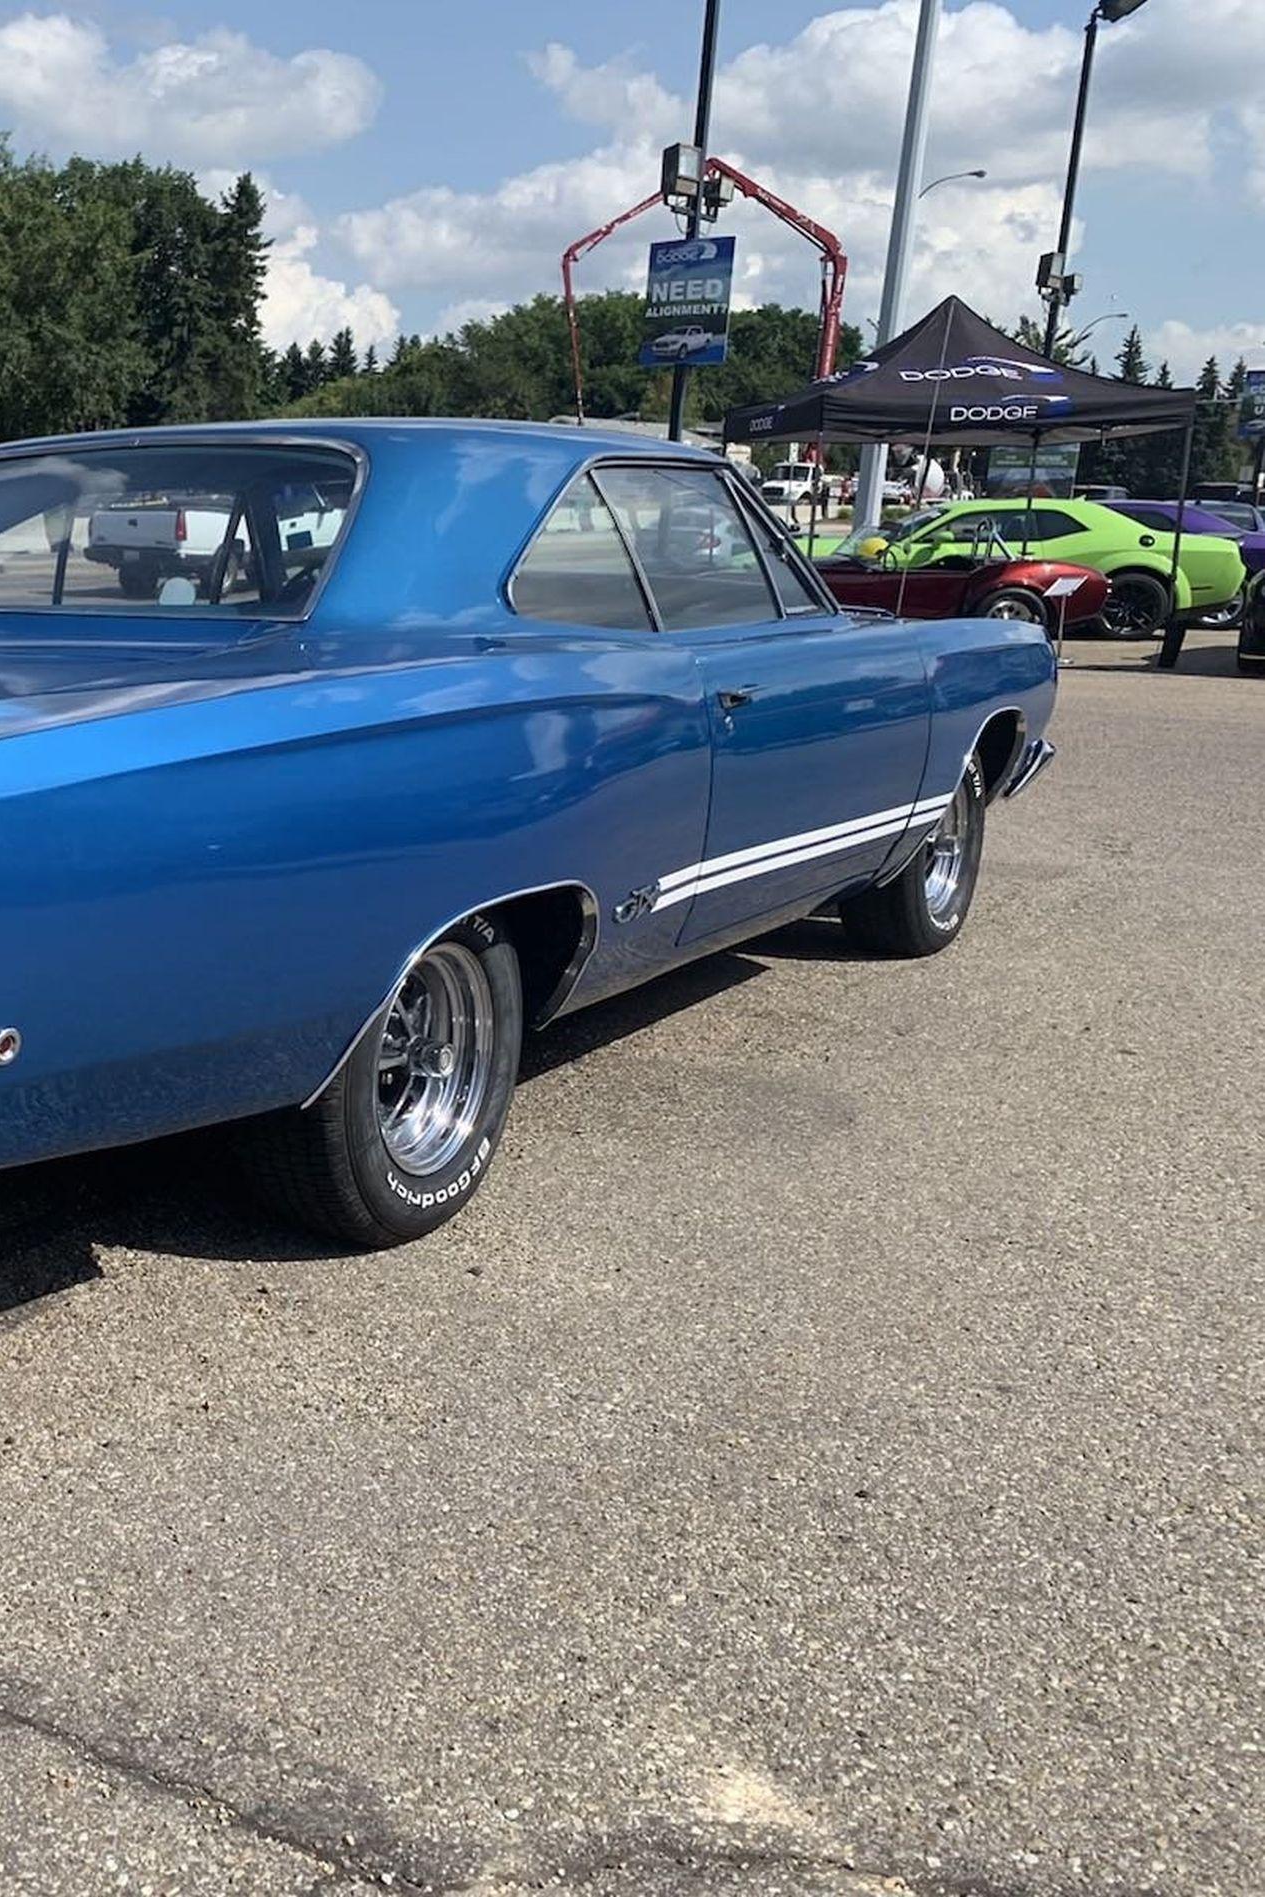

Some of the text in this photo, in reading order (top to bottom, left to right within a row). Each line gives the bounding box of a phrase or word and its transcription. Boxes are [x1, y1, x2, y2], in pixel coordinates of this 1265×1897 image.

[652, 278, 723, 303] NEED
[645, 302, 728, 318] ALIGNMENT?
[899, 364, 1024, 381] DODGE
[950, 405, 1038, 421] DODGE
[387, 1136, 491, 1209] BFGoodrich
